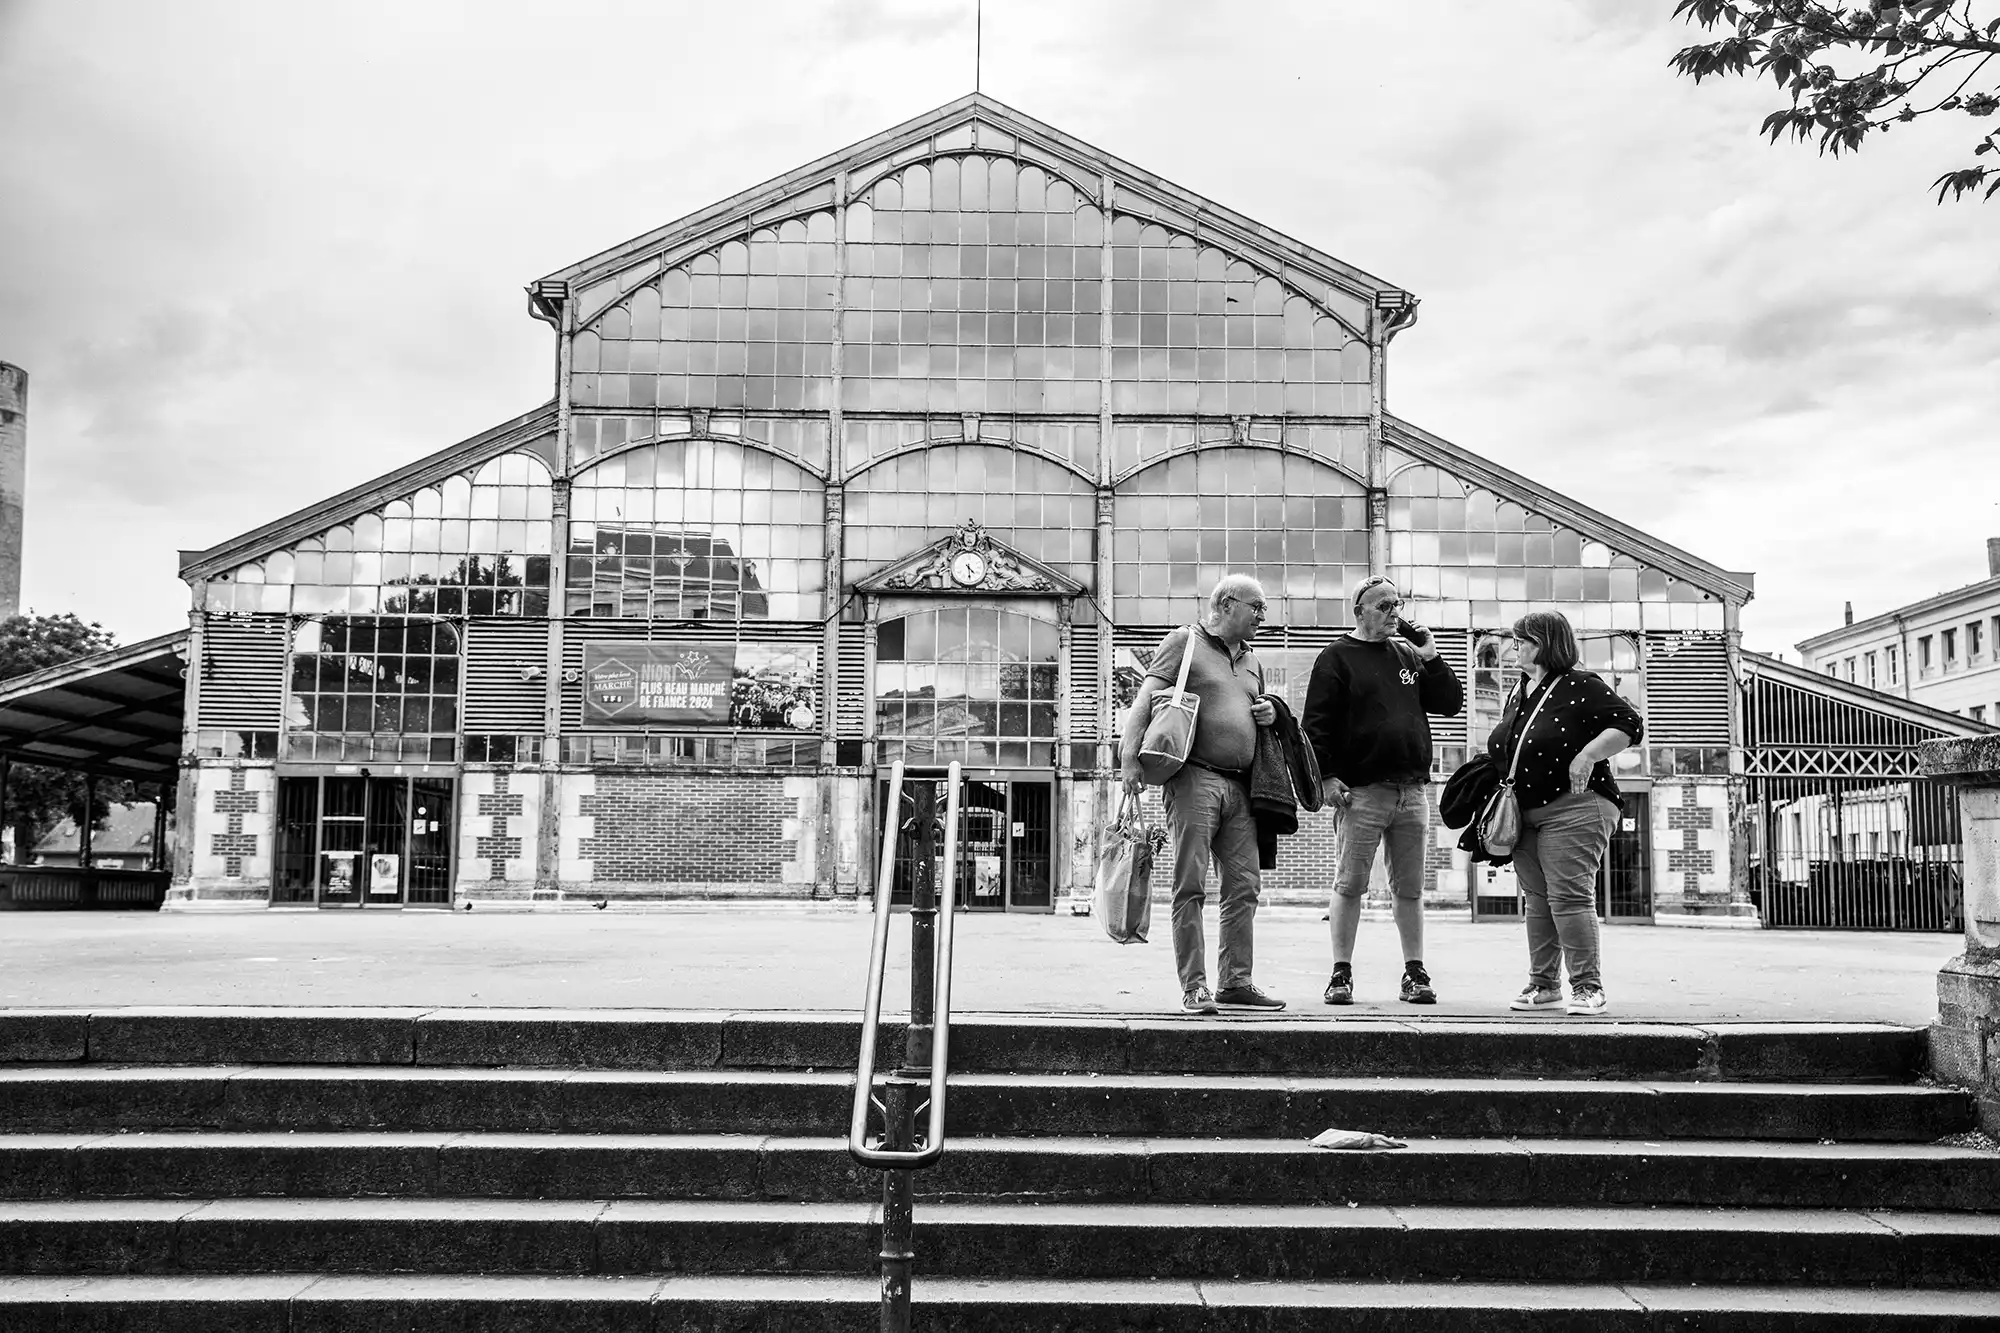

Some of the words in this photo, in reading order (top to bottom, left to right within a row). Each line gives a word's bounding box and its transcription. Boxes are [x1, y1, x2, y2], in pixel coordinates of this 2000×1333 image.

[642, 664, 677, 682] NIORT
[1266, 668, 1288, 684] ORT
[593, 680, 632, 691] MARCHÉ
[640, 681, 663, 695] PLUS
[664, 682, 688, 695] BEAU
[690, 681, 726, 696] MARCHÉ
[640, 696, 652, 708] DE
[652, 696, 687, 708] FRANCE
[689, 696, 714, 709] 2024
